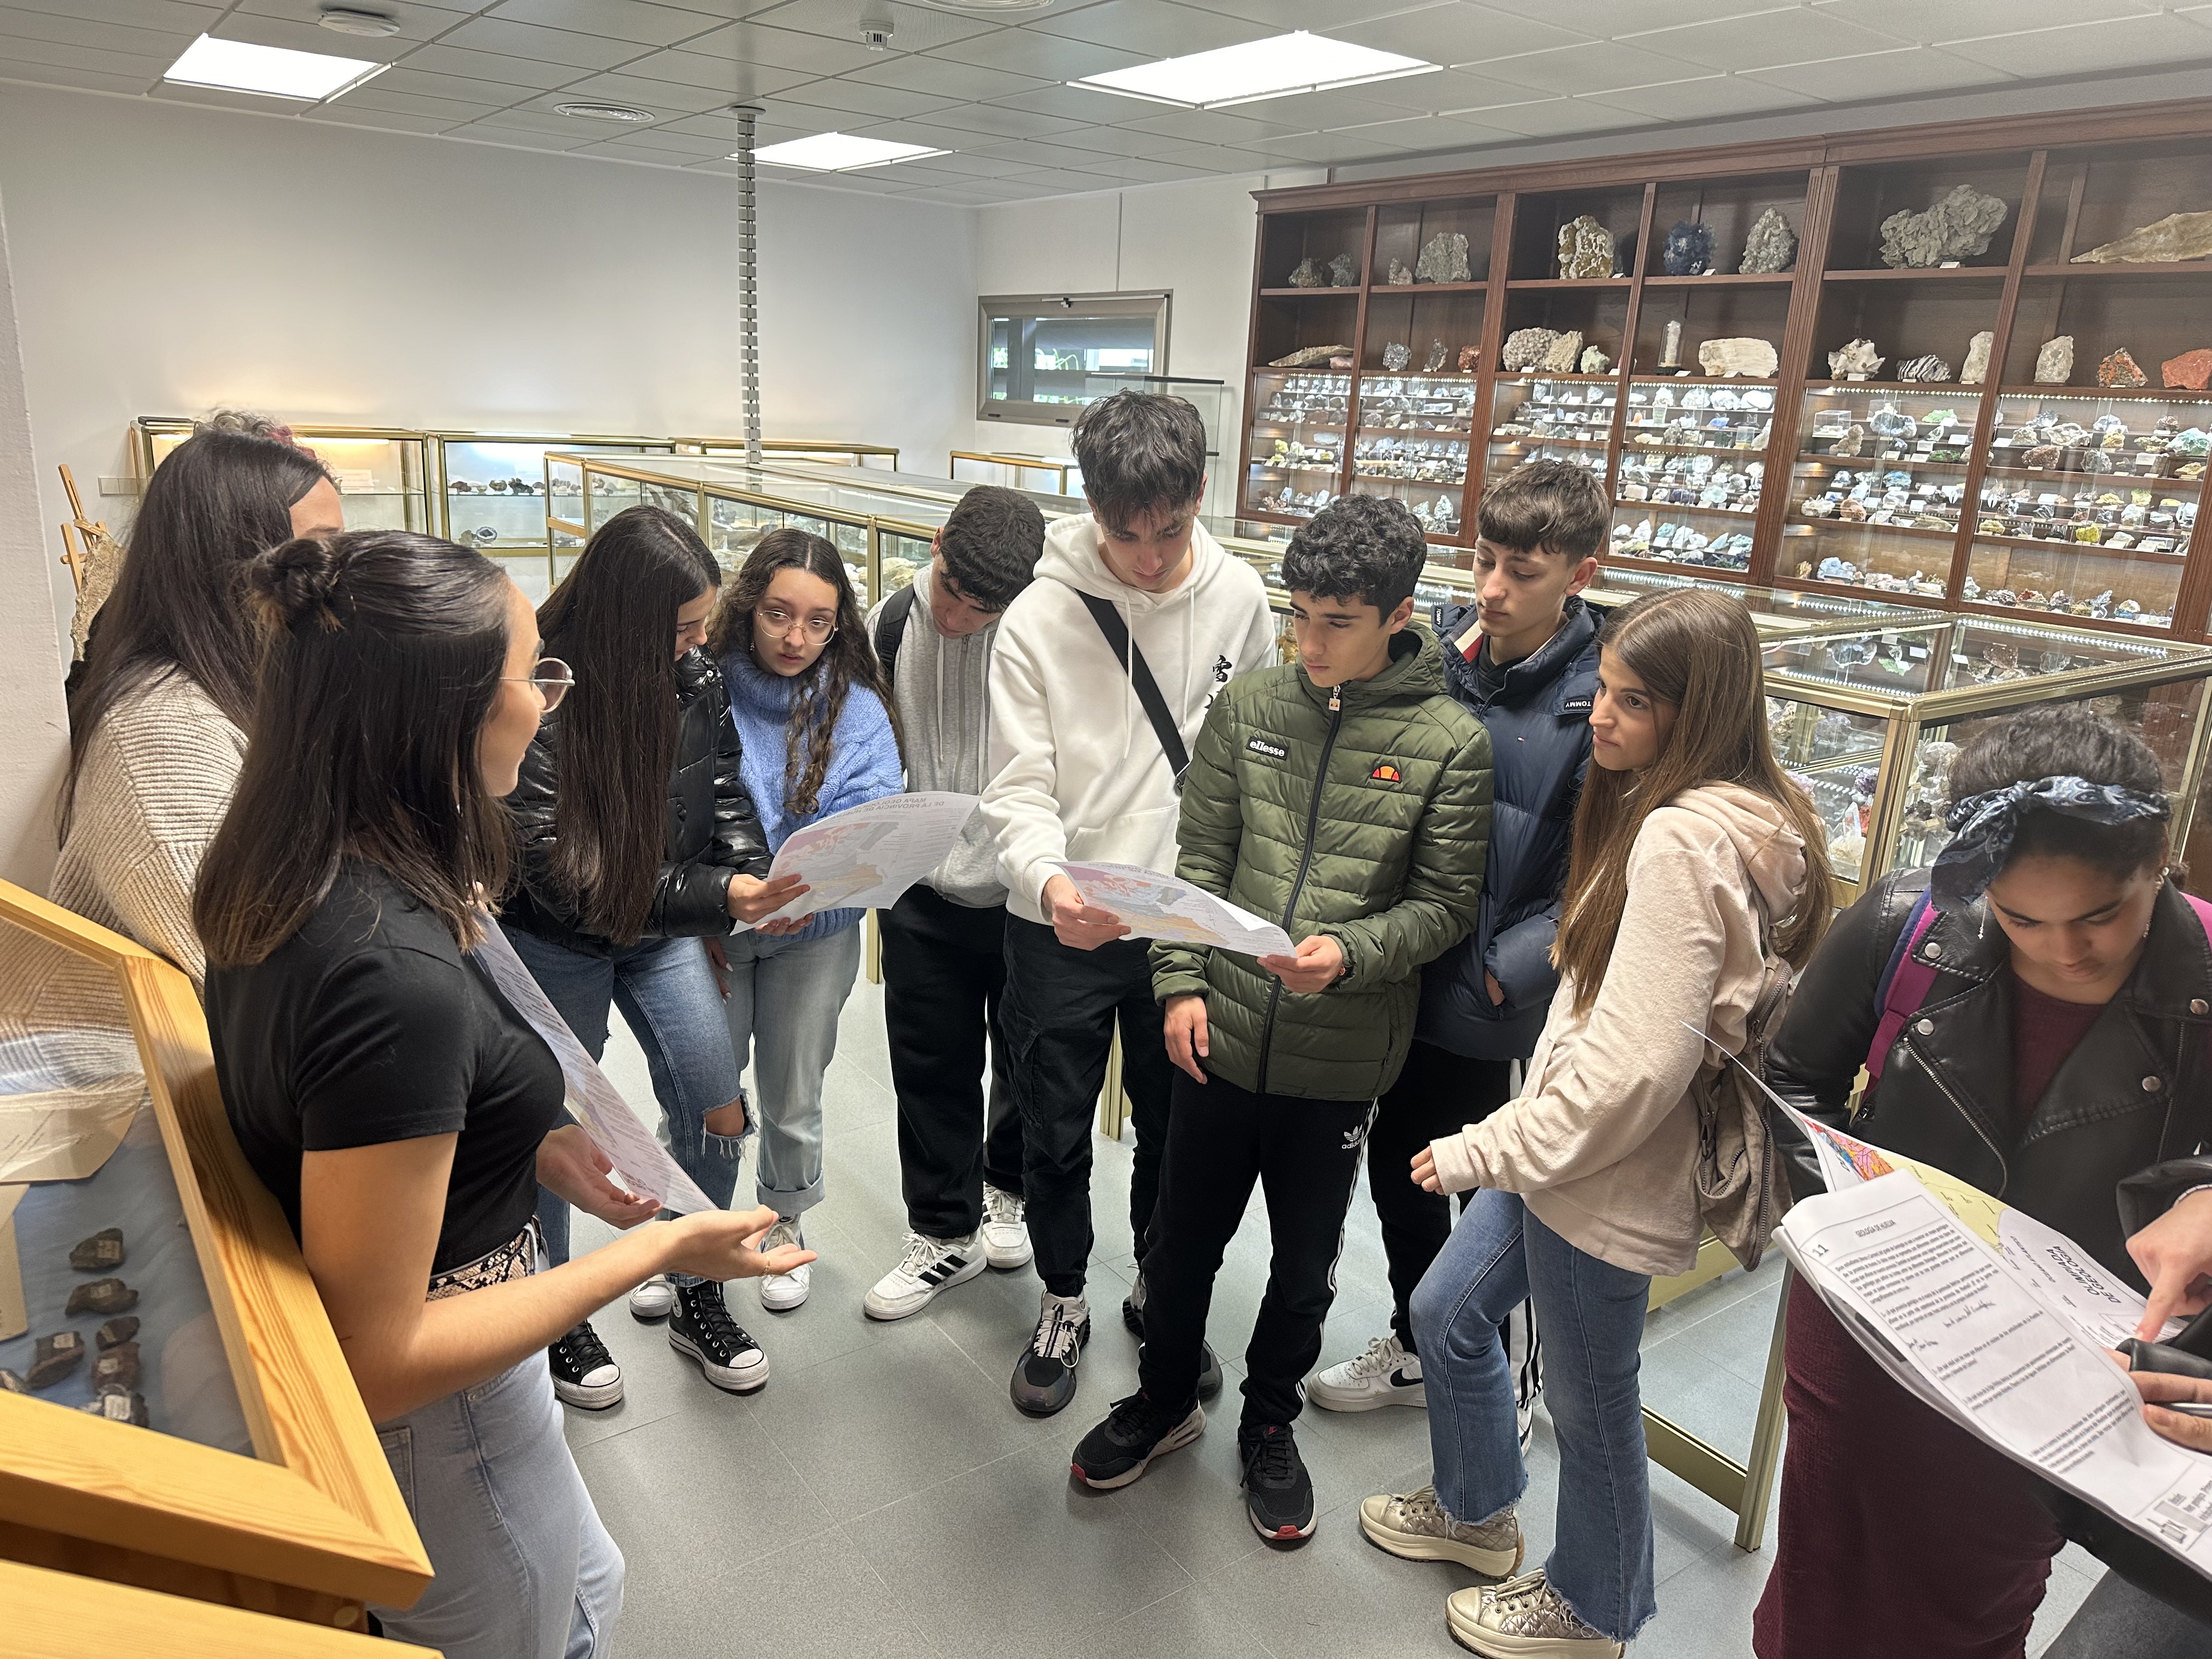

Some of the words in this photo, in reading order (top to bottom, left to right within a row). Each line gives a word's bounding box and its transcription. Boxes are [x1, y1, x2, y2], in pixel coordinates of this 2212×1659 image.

[1249, 740, 1285, 757] ellesse
[1812, 1244, 1829, 1257] 11
[2046, 1249, 2101, 1296] OLIMPIADA
[2101, 1291, 2121, 1304] DE
